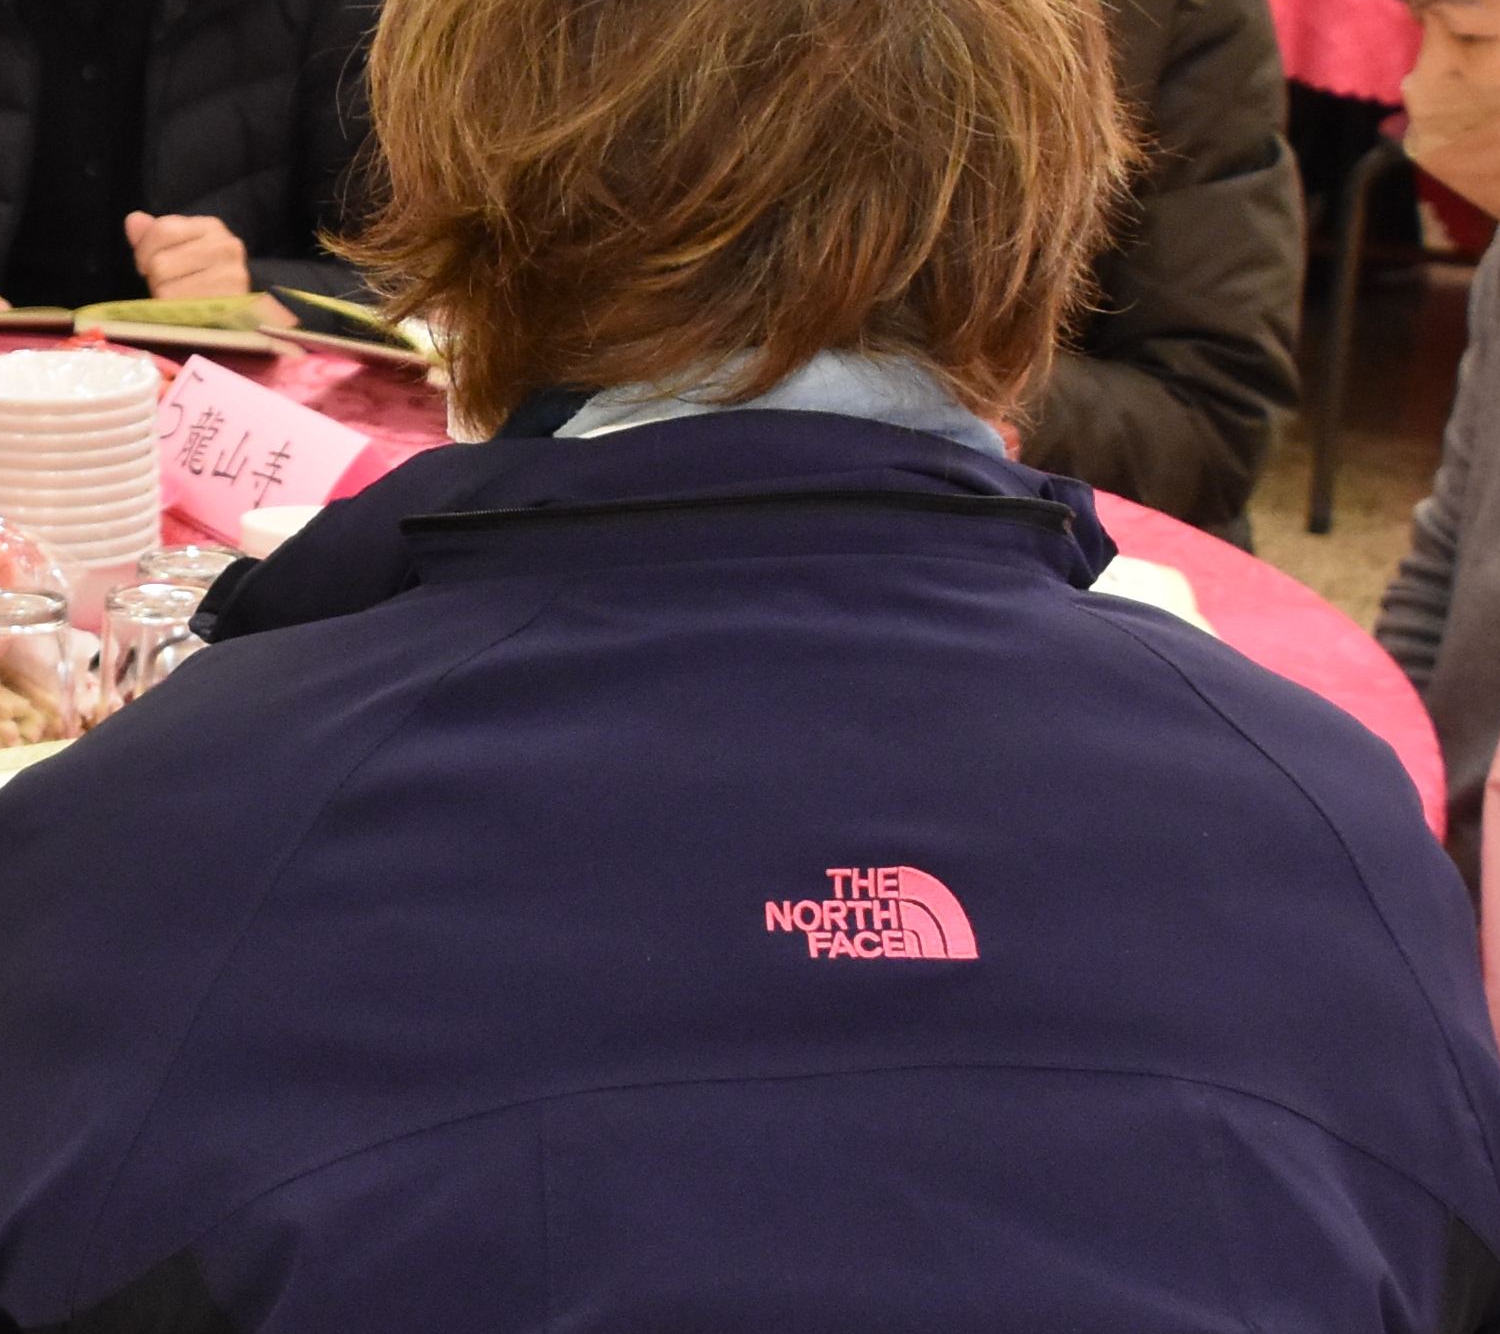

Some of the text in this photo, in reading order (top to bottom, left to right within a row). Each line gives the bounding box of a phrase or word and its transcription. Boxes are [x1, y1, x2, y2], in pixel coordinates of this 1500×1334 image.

[825, 867, 899, 899] THE
[765, 900, 899, 932] NORTH
[807, 931, 904, 959] FACE
